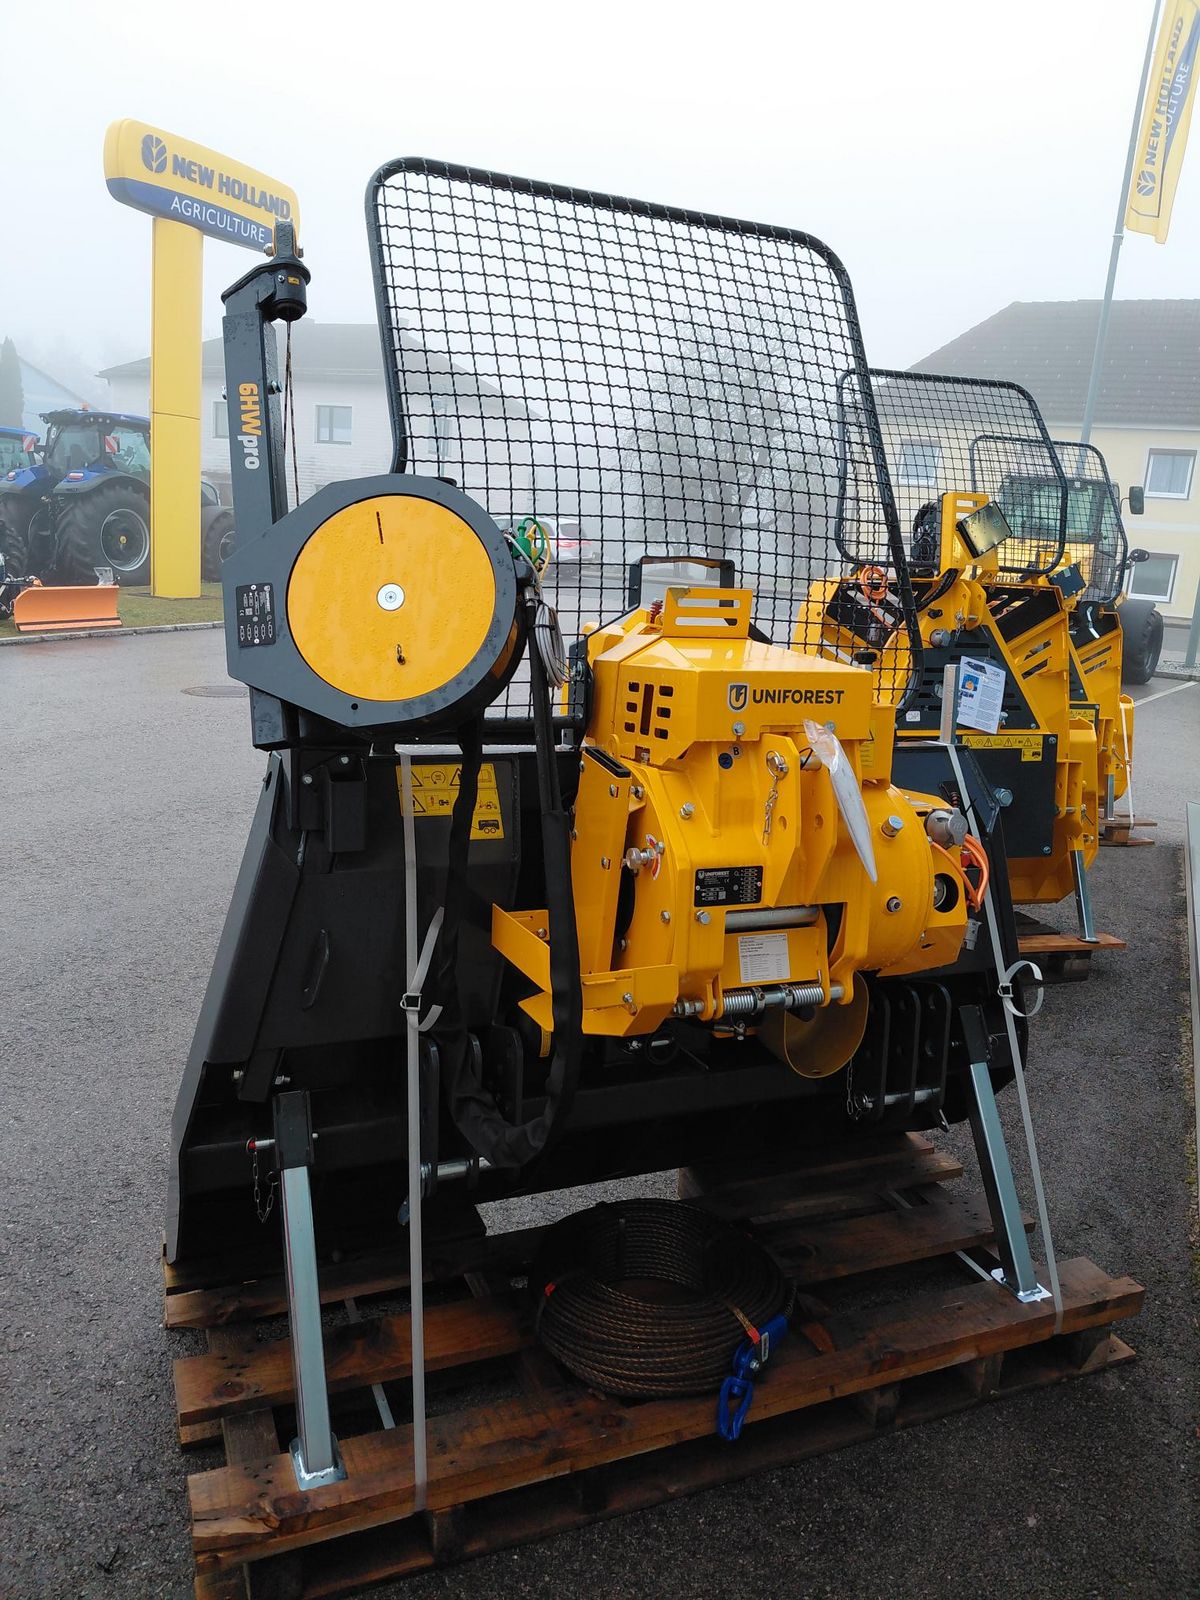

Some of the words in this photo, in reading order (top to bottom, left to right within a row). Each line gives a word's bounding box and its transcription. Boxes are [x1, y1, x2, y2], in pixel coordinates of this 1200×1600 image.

[1144, 119, 1163, 167] NEW
[172, 154, 215, 189] NEW
[218, 173, 291, 220] HOLLAND
[170, 196, 266, 243] AGRICULTURE
[752, 689, 845, 704] UNIFOREST
[732, 746, 740, 756] B
